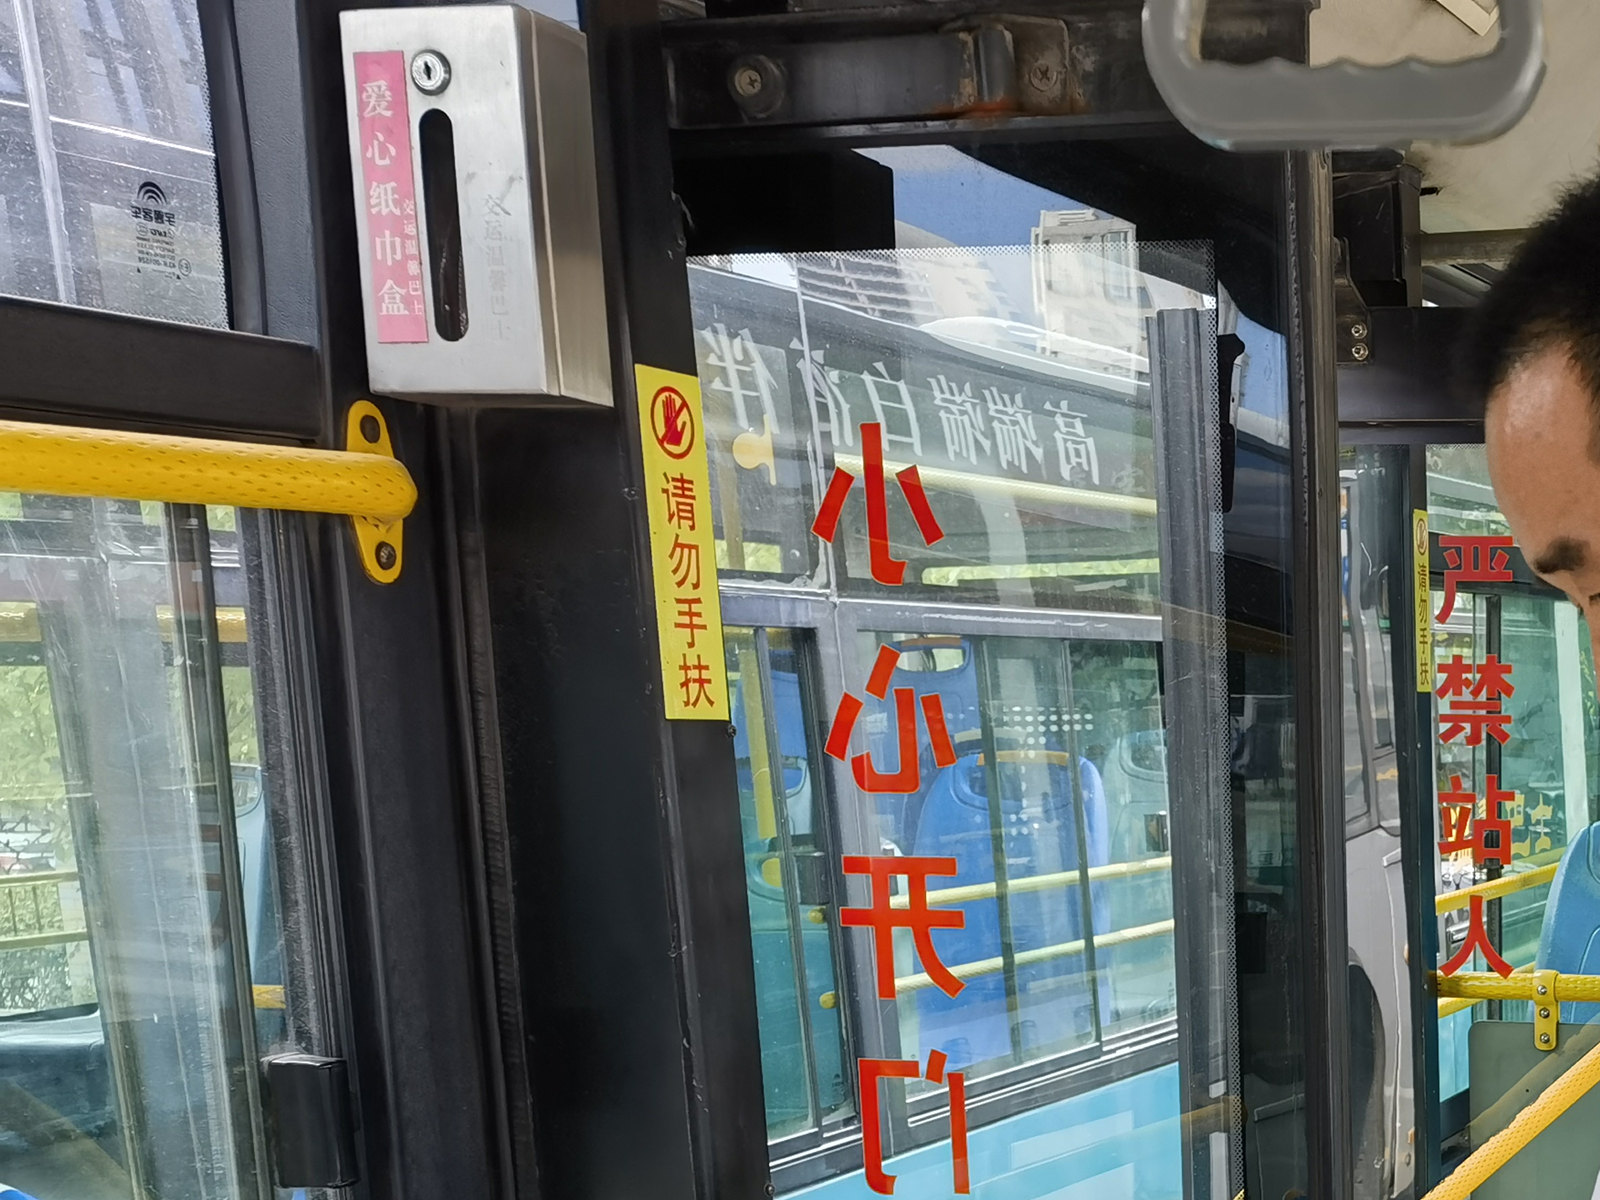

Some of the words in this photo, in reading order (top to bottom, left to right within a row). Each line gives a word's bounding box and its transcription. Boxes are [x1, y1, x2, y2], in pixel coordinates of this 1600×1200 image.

[362, 80, 409, 316] 爱心纸巾盒
[661, 472, 715, 708] 请勿手扶
[1435, 535, 1515, 980] 严禁站人
